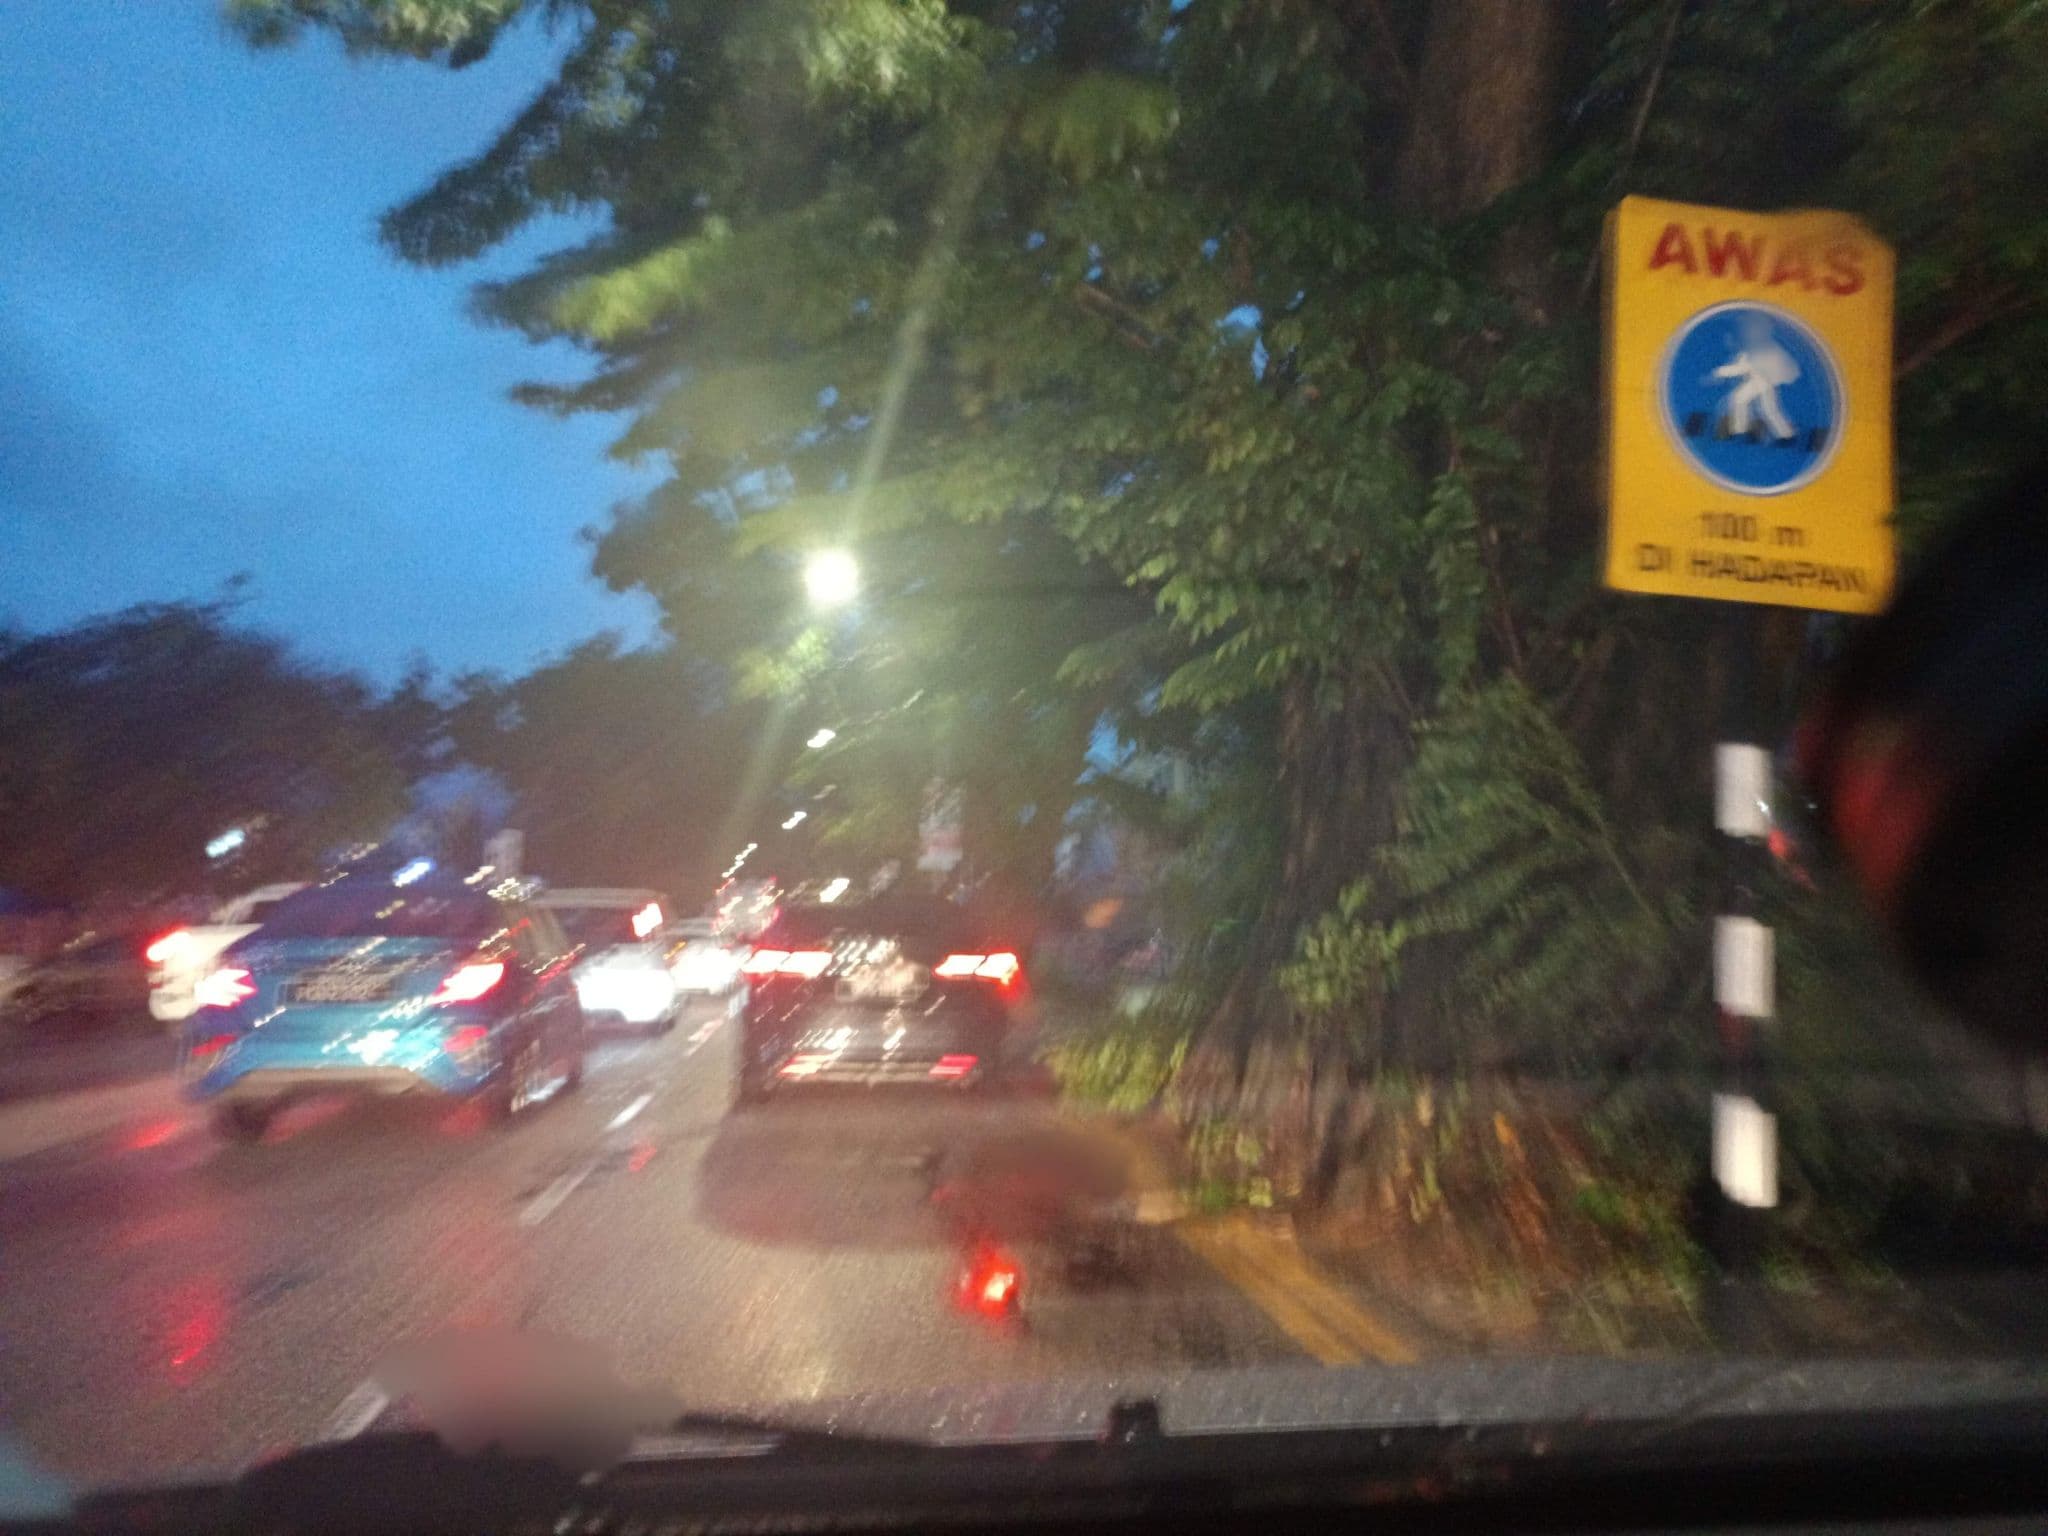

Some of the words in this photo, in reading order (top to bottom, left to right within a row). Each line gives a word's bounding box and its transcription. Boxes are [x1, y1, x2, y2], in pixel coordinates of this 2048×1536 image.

[1648, 222, 1865, 296] AWAS
[1699, 512, 1758, 542] 100
[1773, 525, 1806, 547] m
[1637, 543, 1672, 572] DI
[1688, 550, 1867, 594] HADAPAN
